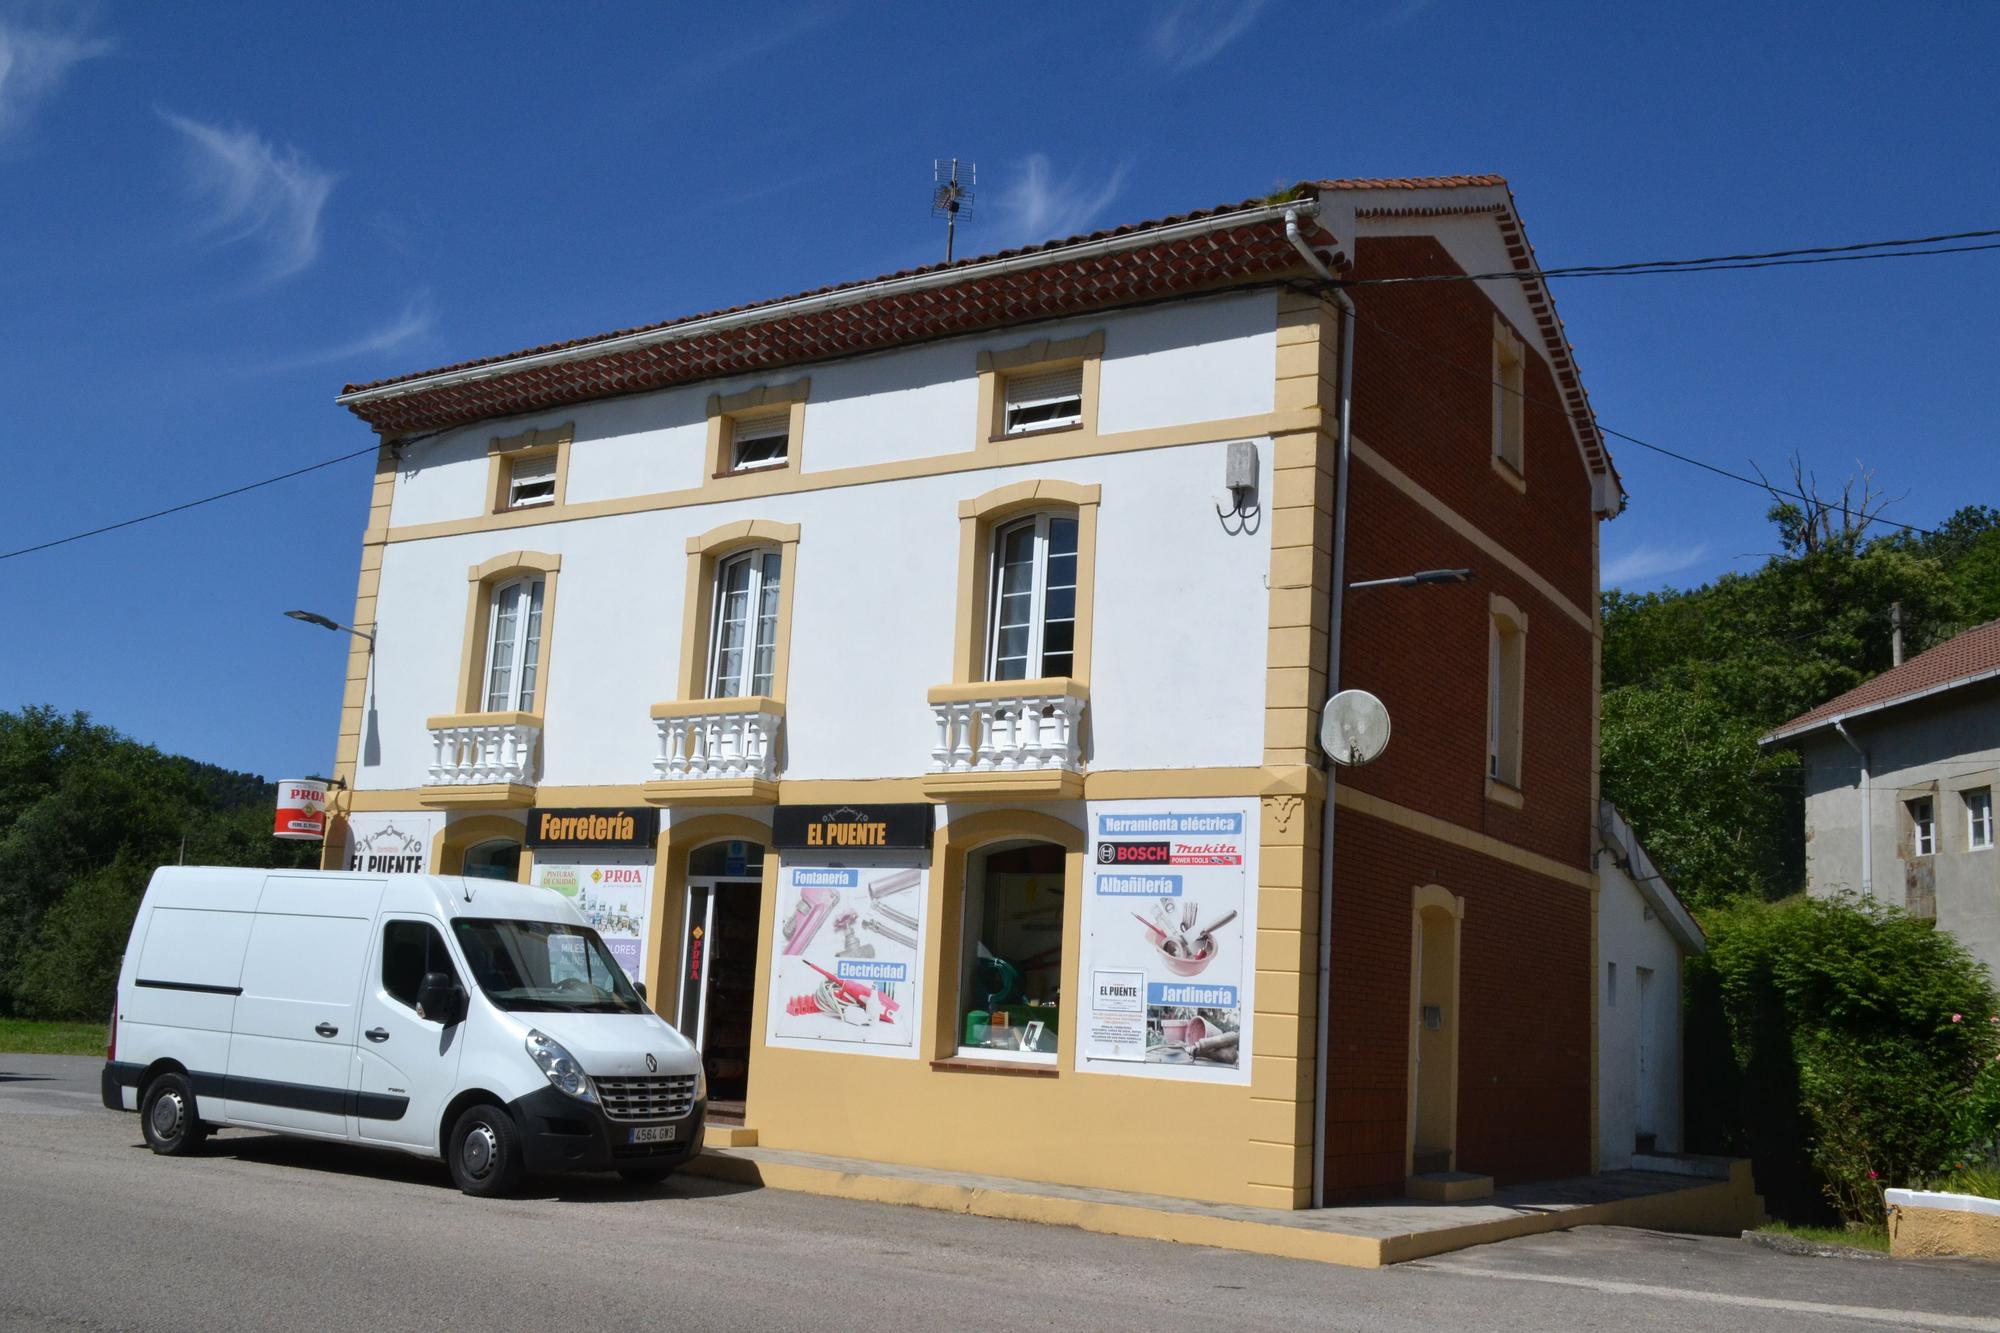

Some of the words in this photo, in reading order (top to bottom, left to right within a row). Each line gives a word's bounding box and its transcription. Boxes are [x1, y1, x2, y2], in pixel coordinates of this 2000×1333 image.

[540, 811, 634, 840] Ferretería
[1106, 818, 1179, 832] Herramienta
[1180, 816, 1235, 831] eléctrica
[807, 823, 823, 845] EL
[827, 822, 886, 845] PUENTE
[1117, 846, 1168, 861] BOSCH
[604, 869, 642, 883] PROA
[794, 870, 849, 885] Fontanería
[1100, 877, 1173, 893] Albañilería
[690, 940, 701, 981] PROA
[840, 962, 904, 979] Electricidad
[1100, 986, 1108, 996] EL
[1109, 986, 1137, 997] PUENTE
[1161, 985, 1232, 1005] Jardinería
